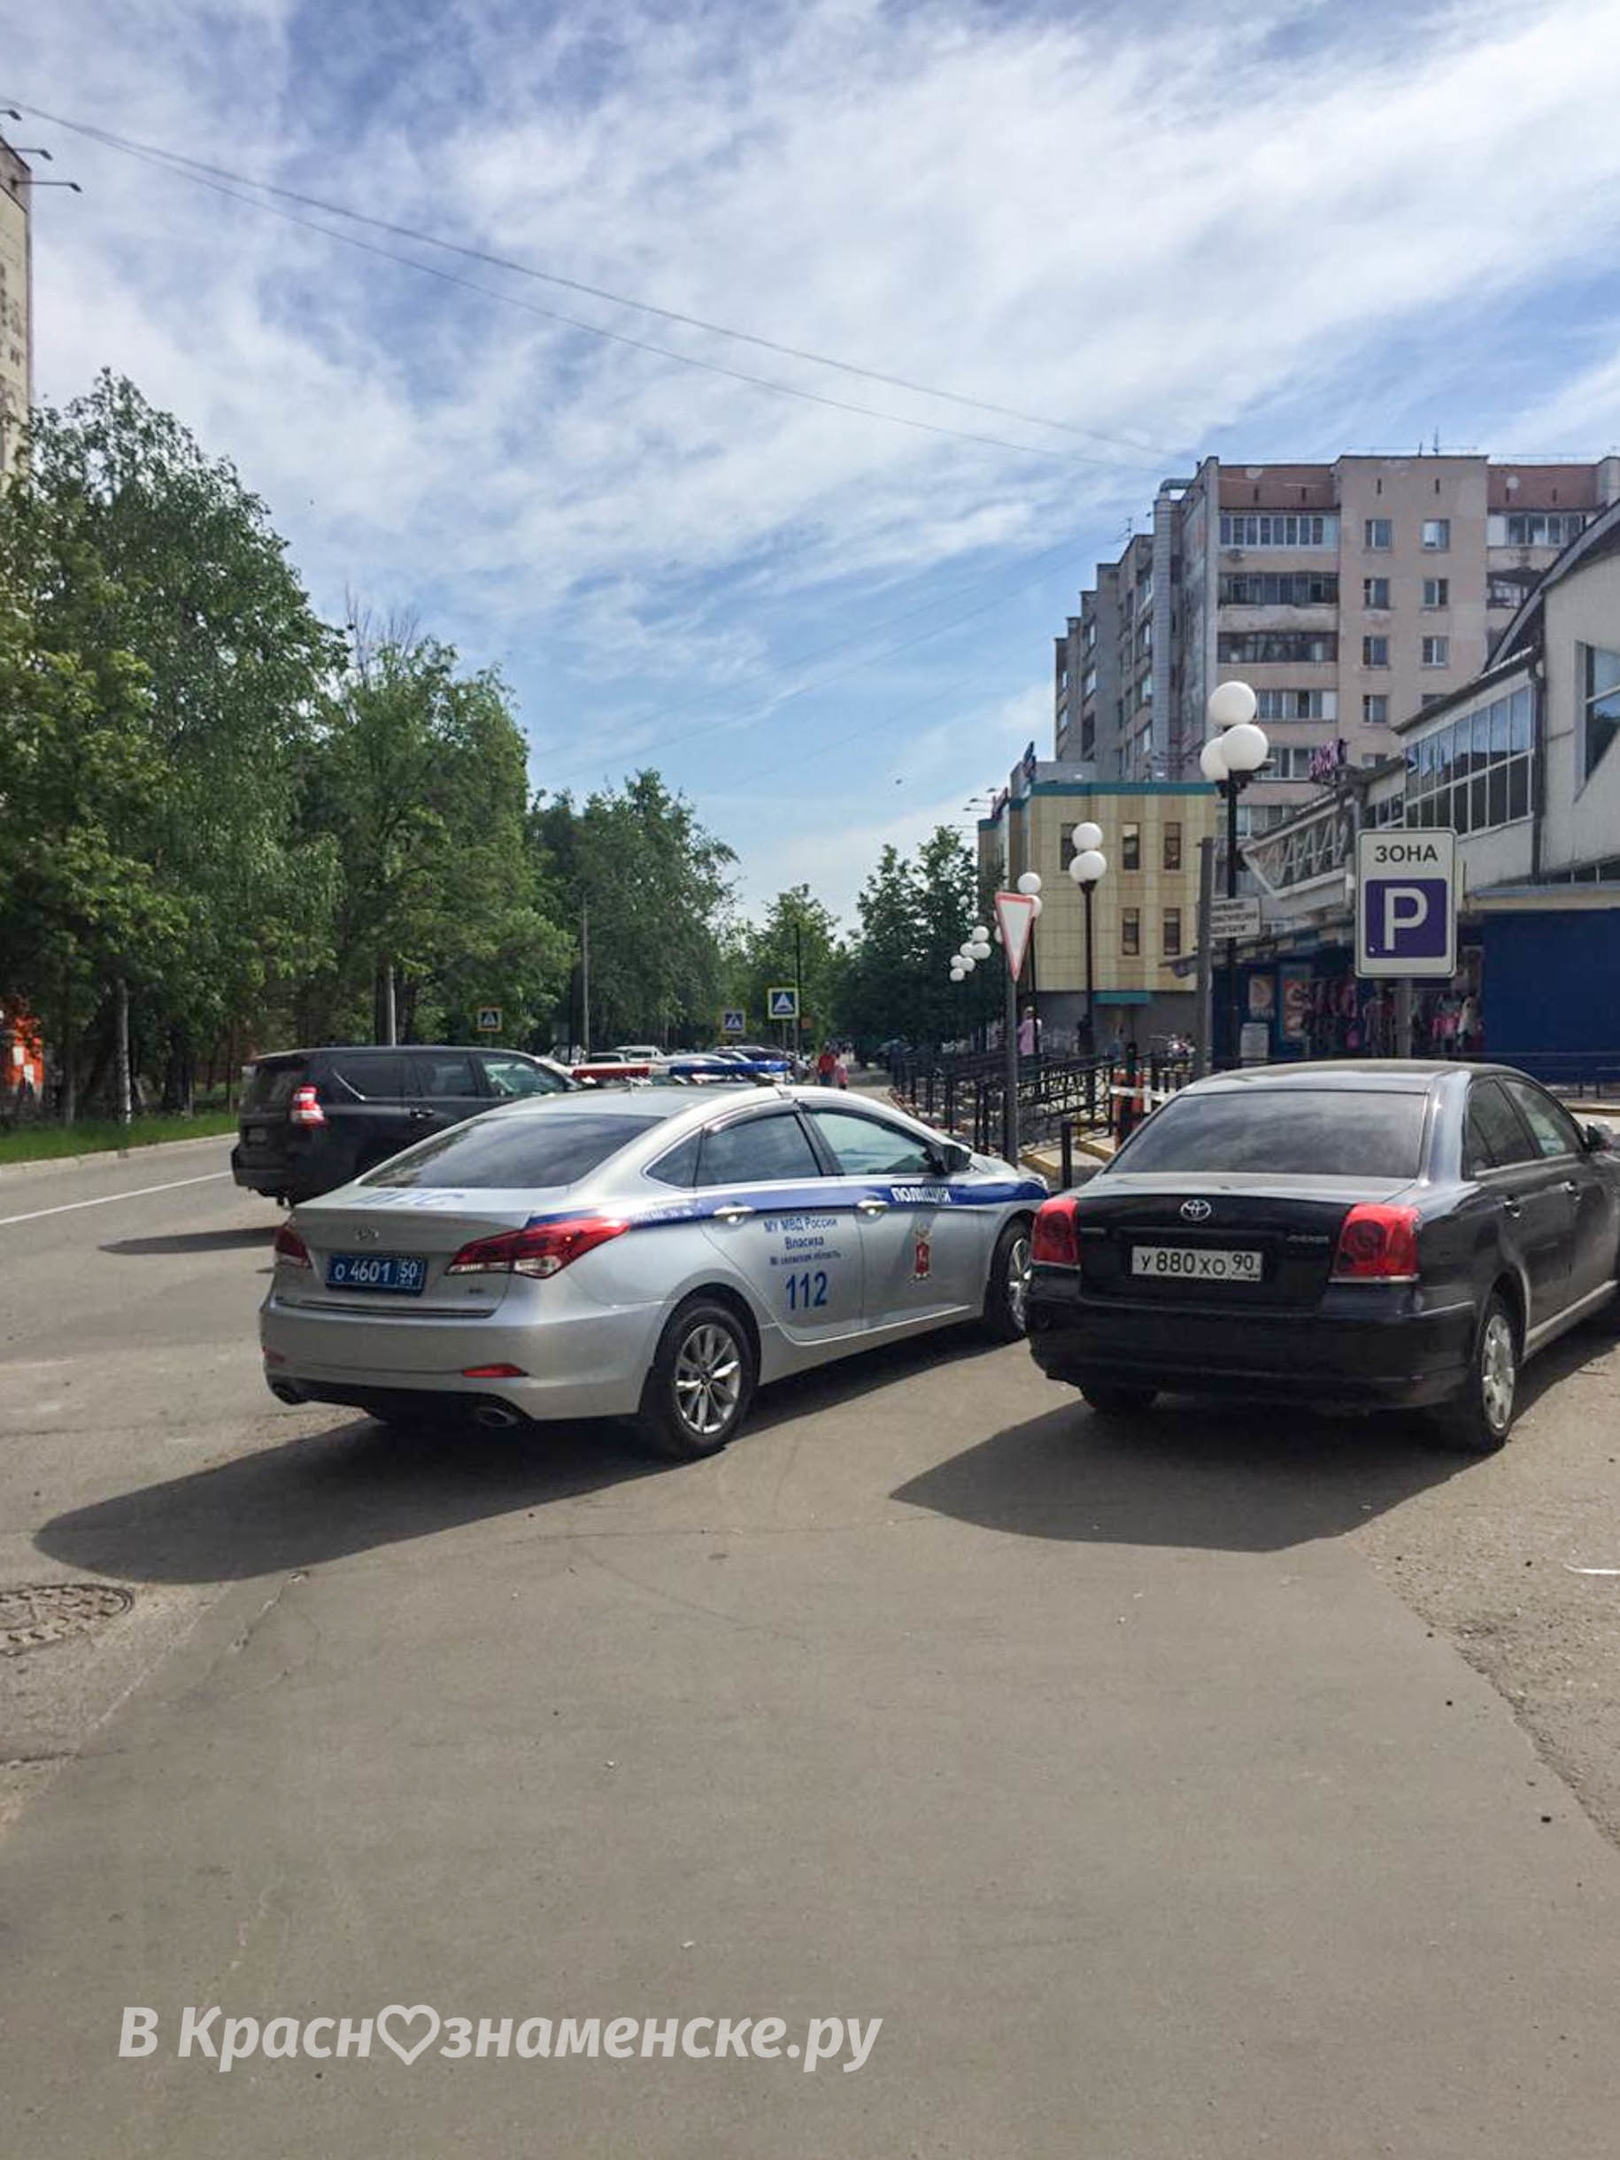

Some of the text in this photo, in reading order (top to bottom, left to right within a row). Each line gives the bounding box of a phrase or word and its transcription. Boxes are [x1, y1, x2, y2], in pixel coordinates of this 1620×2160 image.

[1374, 844, 1439, 863] ЗОНА
[1383, 887, 1429, 951] P
[780, 1217, 804, 1231] МВД
[804, 1216, 837, 1229] России
[784, 1235, 825, 1250] Власиха
[785, 1270, 828, 1310] 112
